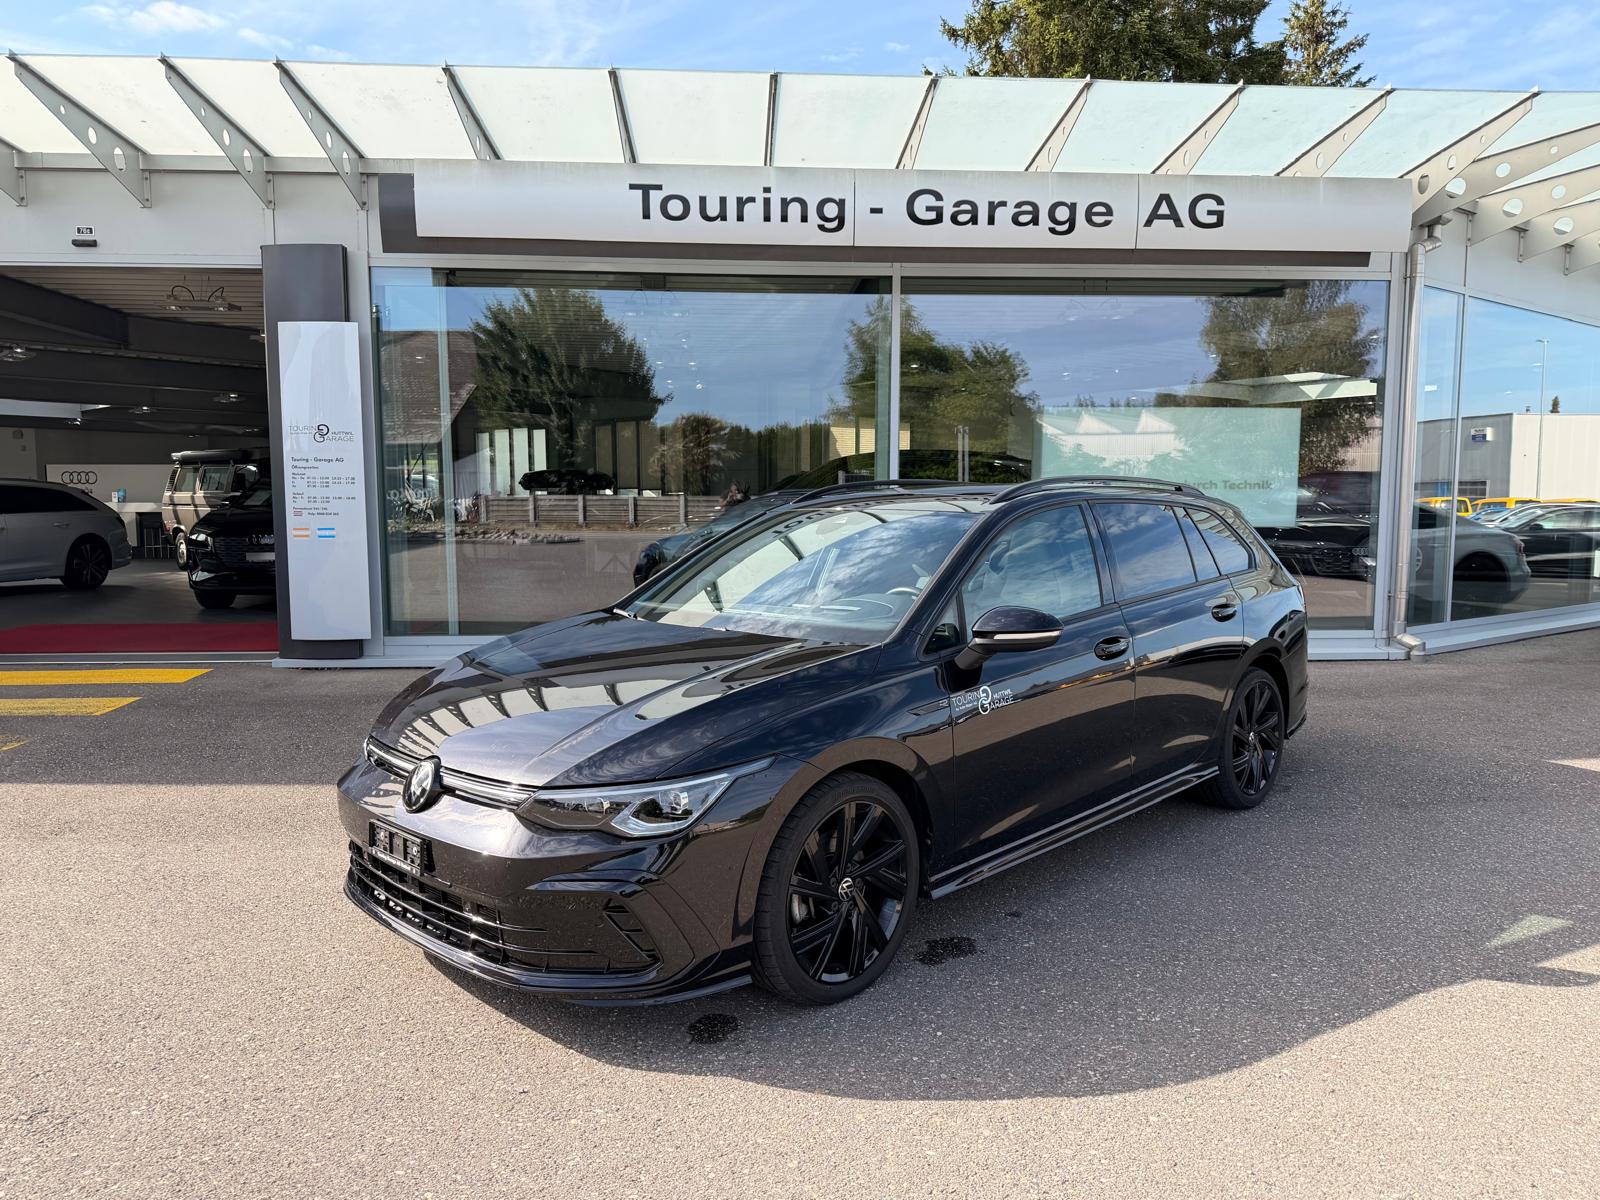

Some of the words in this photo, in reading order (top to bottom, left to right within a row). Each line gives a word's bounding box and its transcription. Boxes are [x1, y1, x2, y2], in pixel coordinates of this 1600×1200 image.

[629, 183, 846, 233] Touring
[906, 188, 1114, 235] Garage
[1143, 193, 1225, 229] AG
[1222, 480, 1274, 490] Technik
